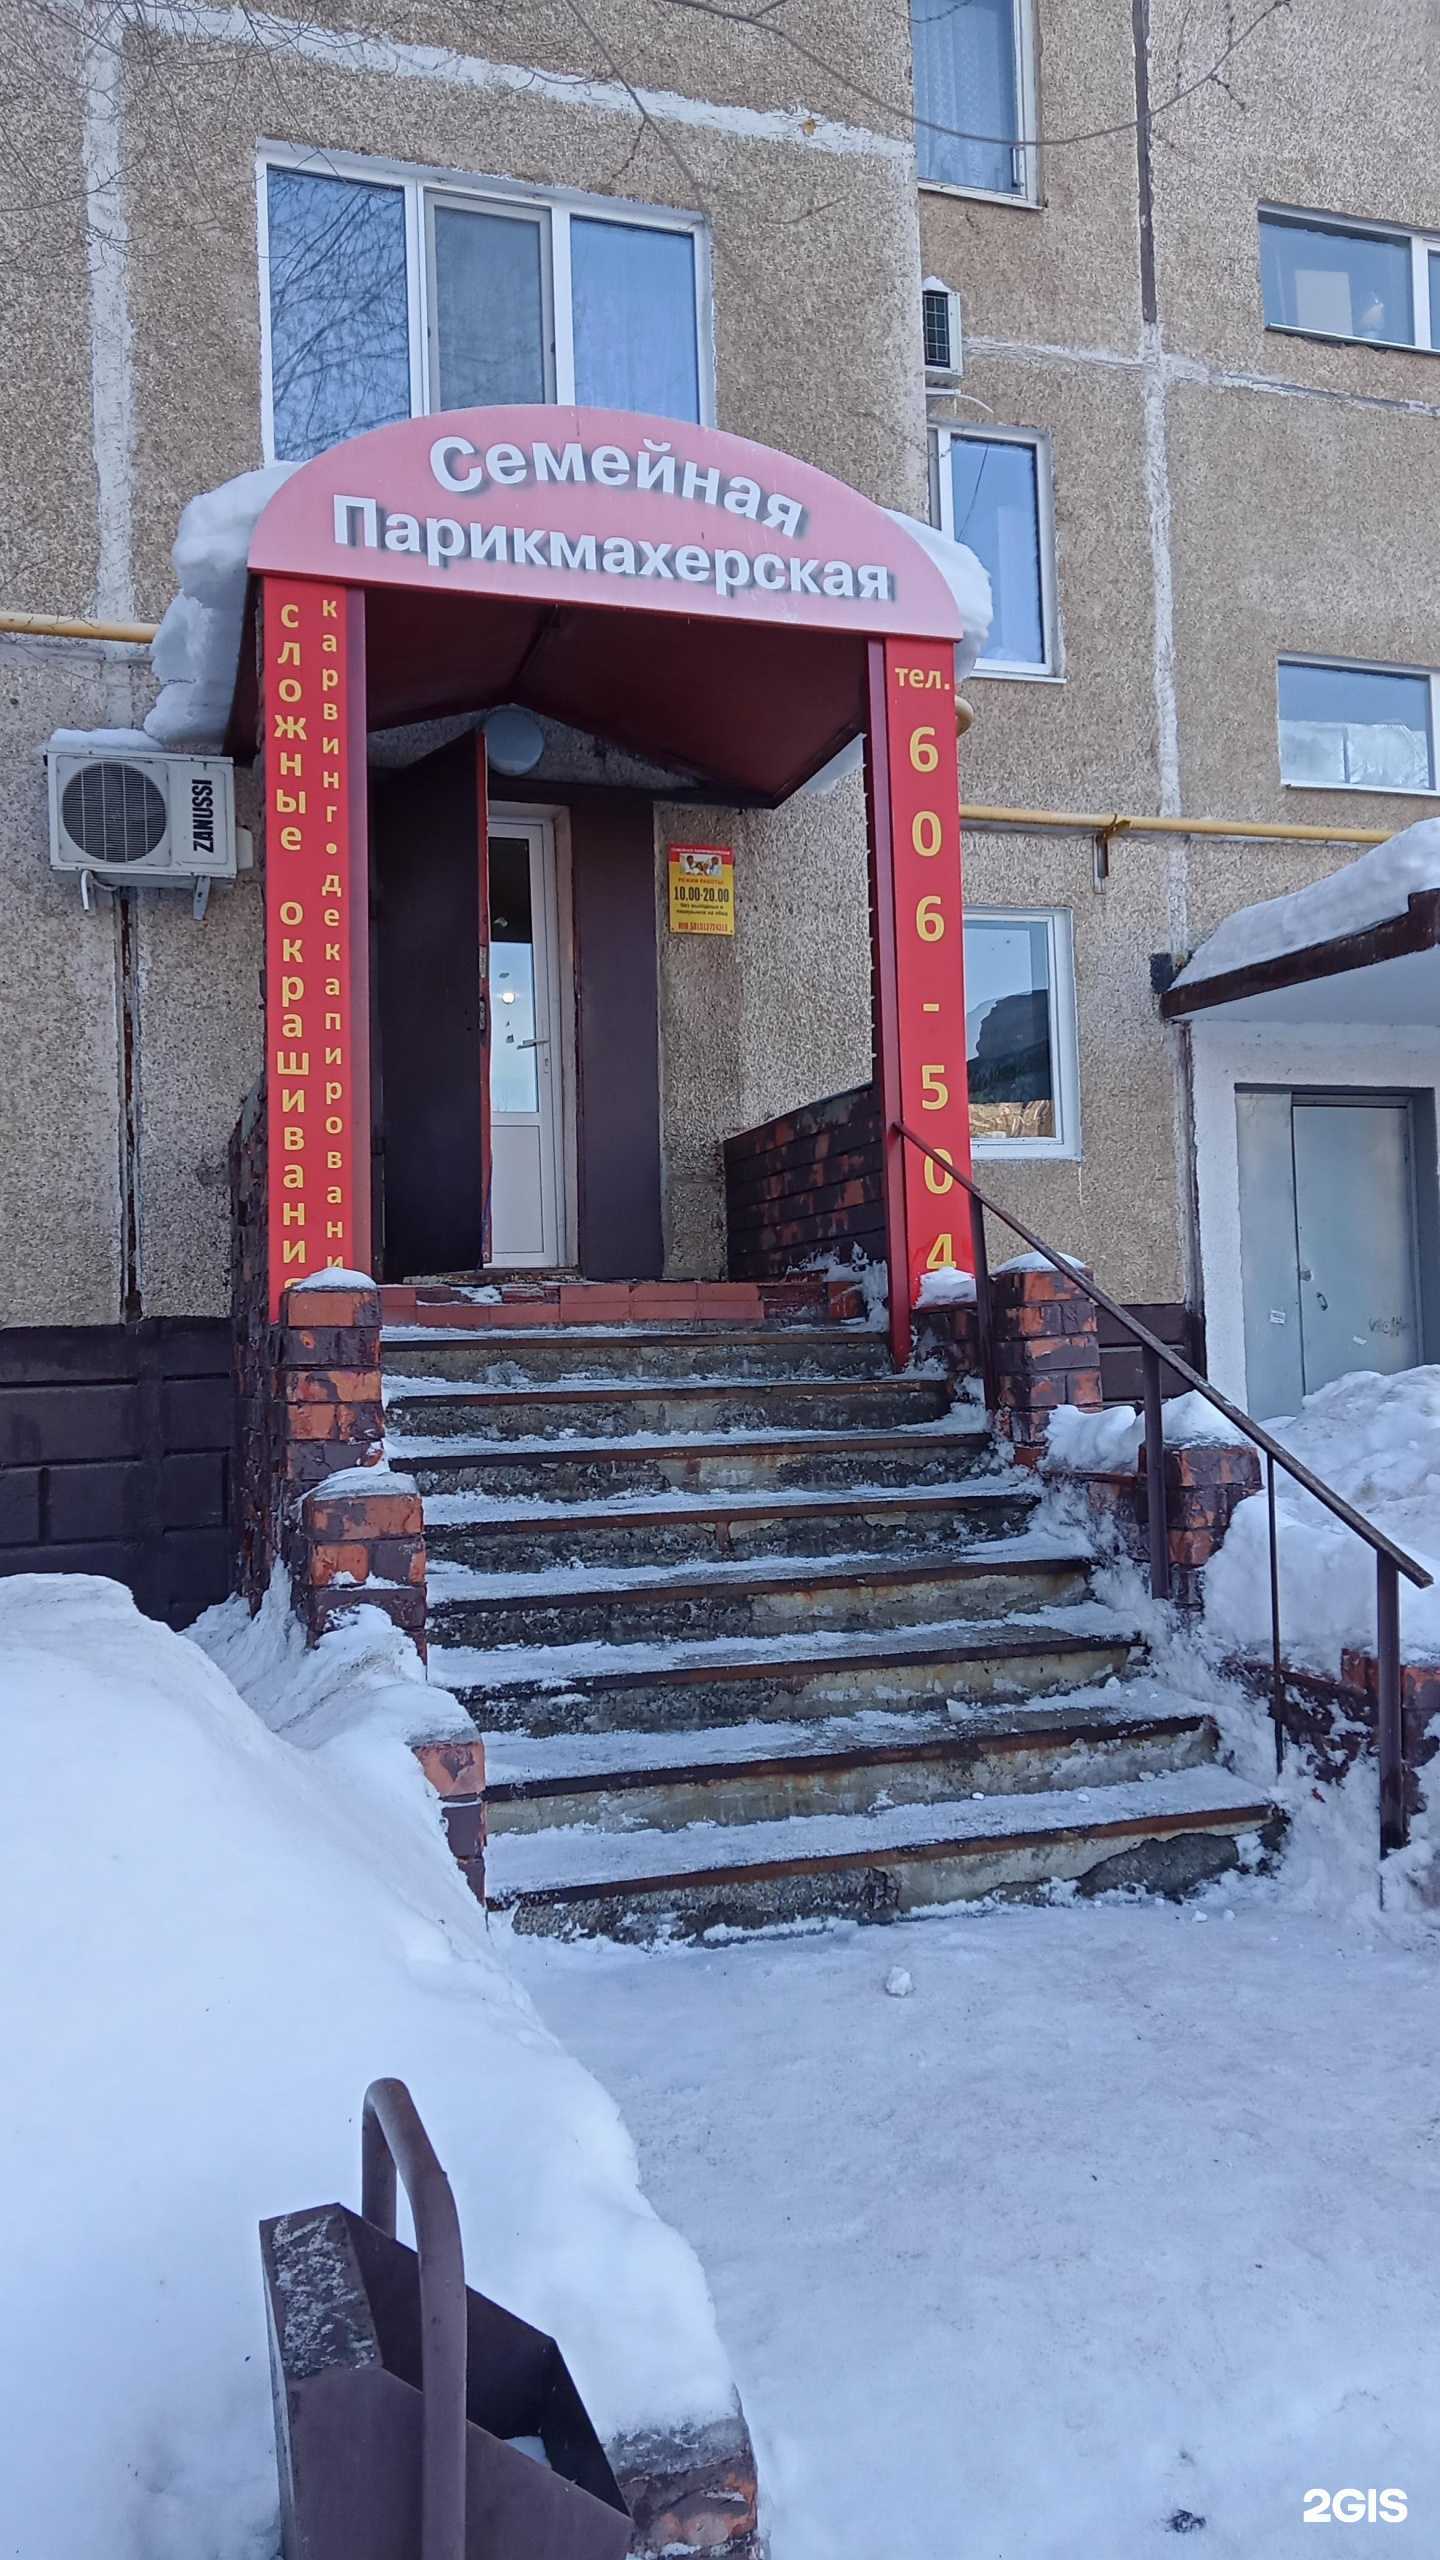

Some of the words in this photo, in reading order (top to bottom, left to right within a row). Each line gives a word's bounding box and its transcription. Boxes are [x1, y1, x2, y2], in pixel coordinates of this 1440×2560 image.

[430, 434, 803, 538] Семейная
[332, 494, 890, 600] Парикмахерская
[273, 603, 308, 851] сложные
[895, 667, 951, 690] тел.
[191, 779, 214, 853] ZANUSSI
